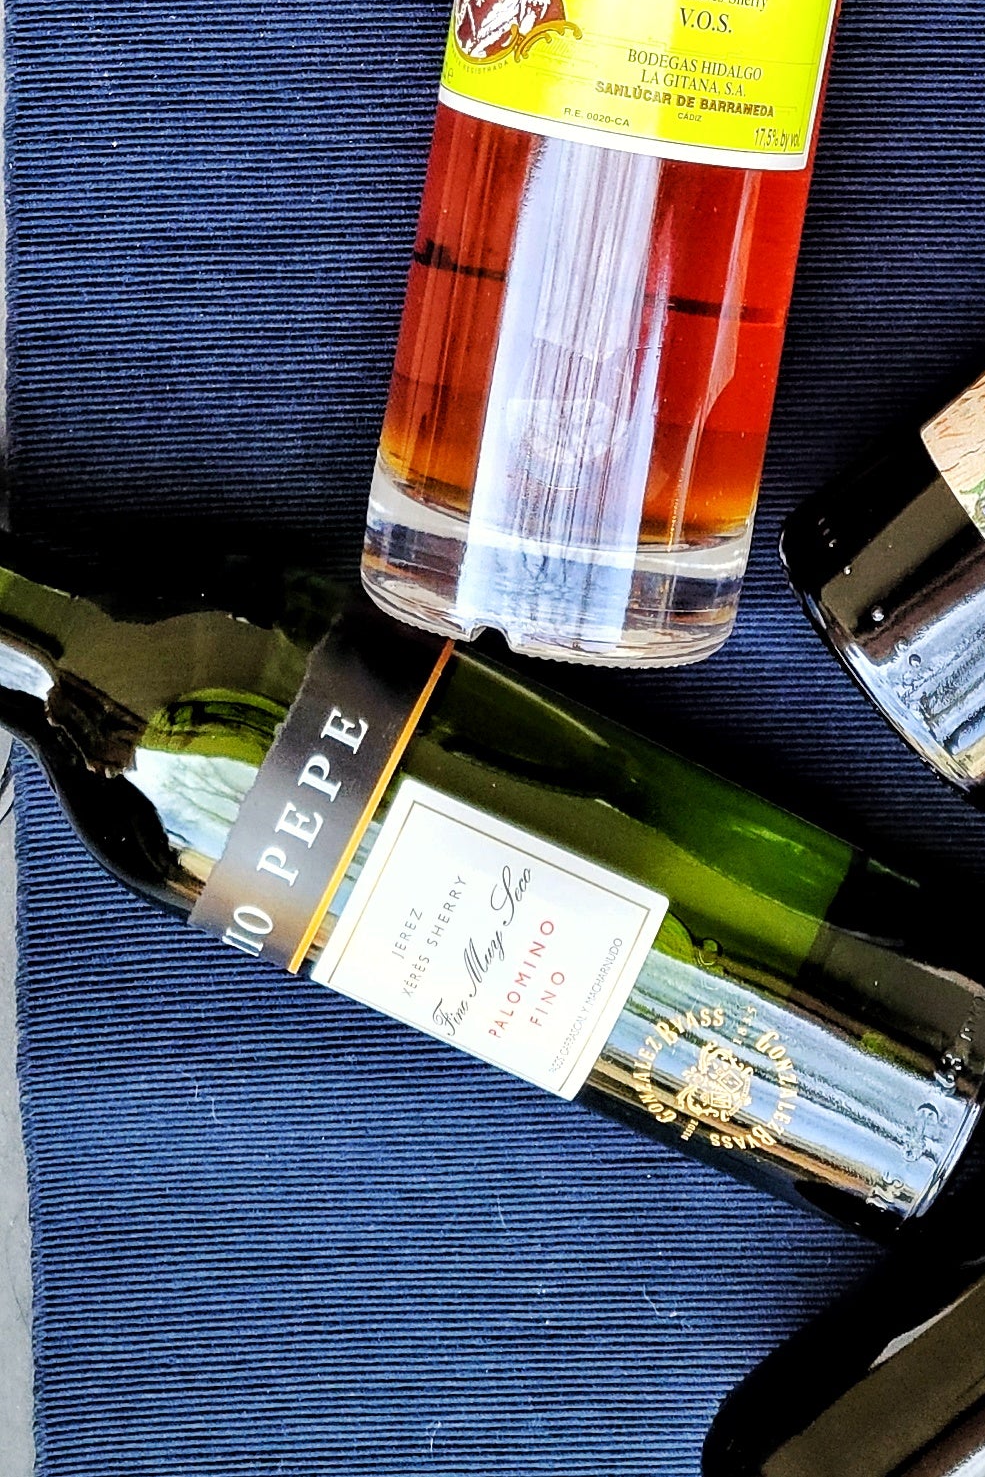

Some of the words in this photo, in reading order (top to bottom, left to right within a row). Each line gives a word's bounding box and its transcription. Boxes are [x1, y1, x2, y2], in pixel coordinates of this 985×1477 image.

[679, 8, 732, 33] V.O.S.
[628, 48, 698, 73] BODEGAS
[701, 60, 763, 81] HIDALGO
[641, 69, 660, 85] LA
[663, 74, 721, 95] GITANA,
[725, 81, 746, 98] S.A.
[564, 106, 584, 119] R.E.
[586, 111, 631, 127] 0020-CA
[595, 80, 672, 105] SANLÚCAR
[676, 94, 696, 109] DE
[699, 96, 775, 118] BARRAMEDA
[780, 131, 790, 152] by
[221, 905, 274, 957] IO
[256, 706, 369, 888] PEPE
[427, 875, 467, 948] SHERRY
[392, 908, 424, 960] JEREZ
[463, 930, 506, 998] Muy
[490, 865, 532, 927] Seco
[488, 920, 555, 1039] PALOMINO
[584, 937, 624, 1007] MACHARNUDO
[529, 971, 566, 1027] FINO
[656, 1008, 725, 1047] BYASS
[709, 1124, 778, 1151] BYASS
